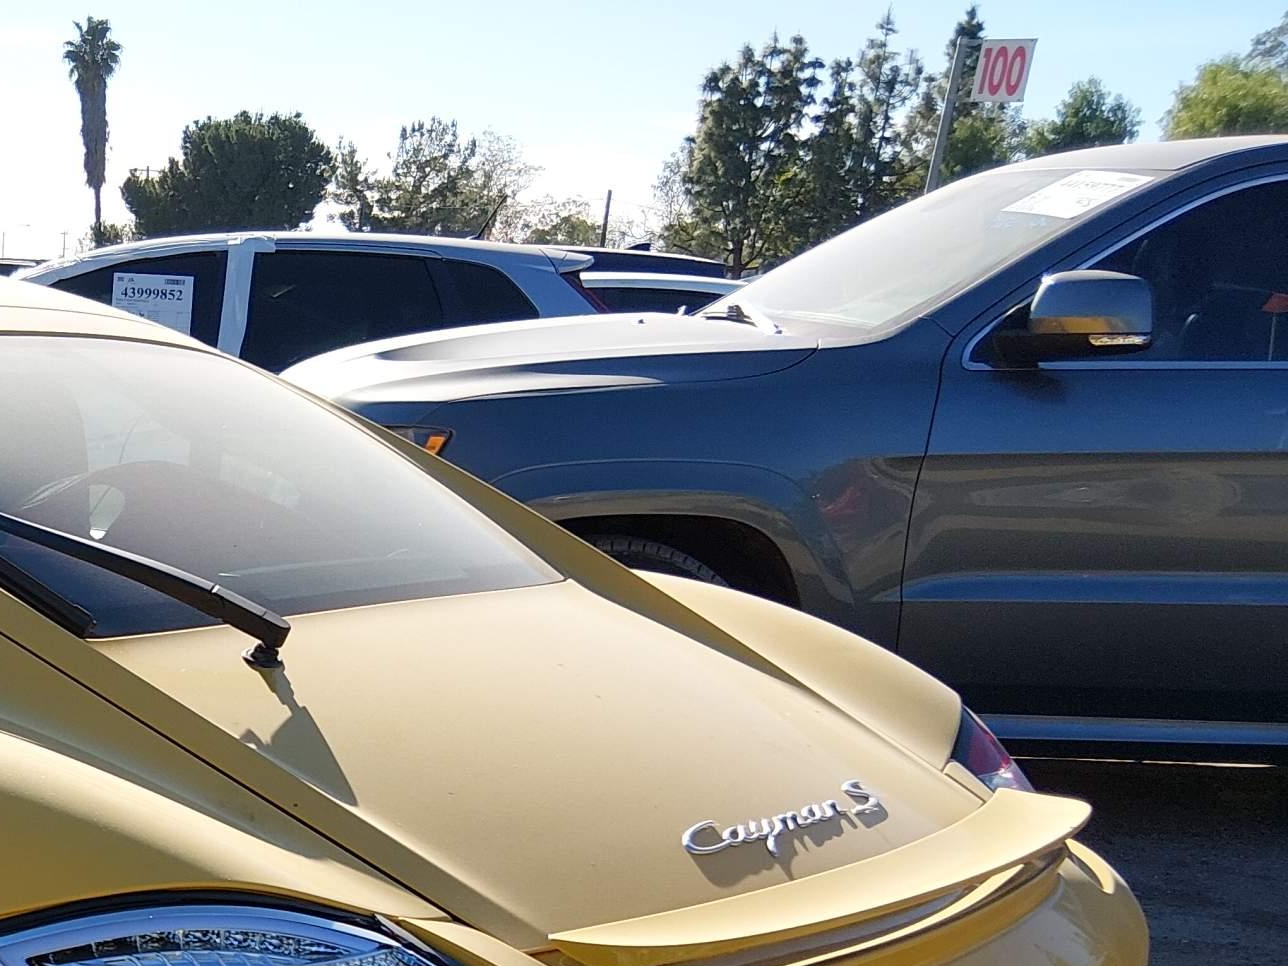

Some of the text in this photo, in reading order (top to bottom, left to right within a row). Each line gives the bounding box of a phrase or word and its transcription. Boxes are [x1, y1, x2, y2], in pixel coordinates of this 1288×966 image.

[978, 46, 1026, 96] 100
[121, 286, 183, 301] 43999852
[682, 779, 880, 857] Cayman S
